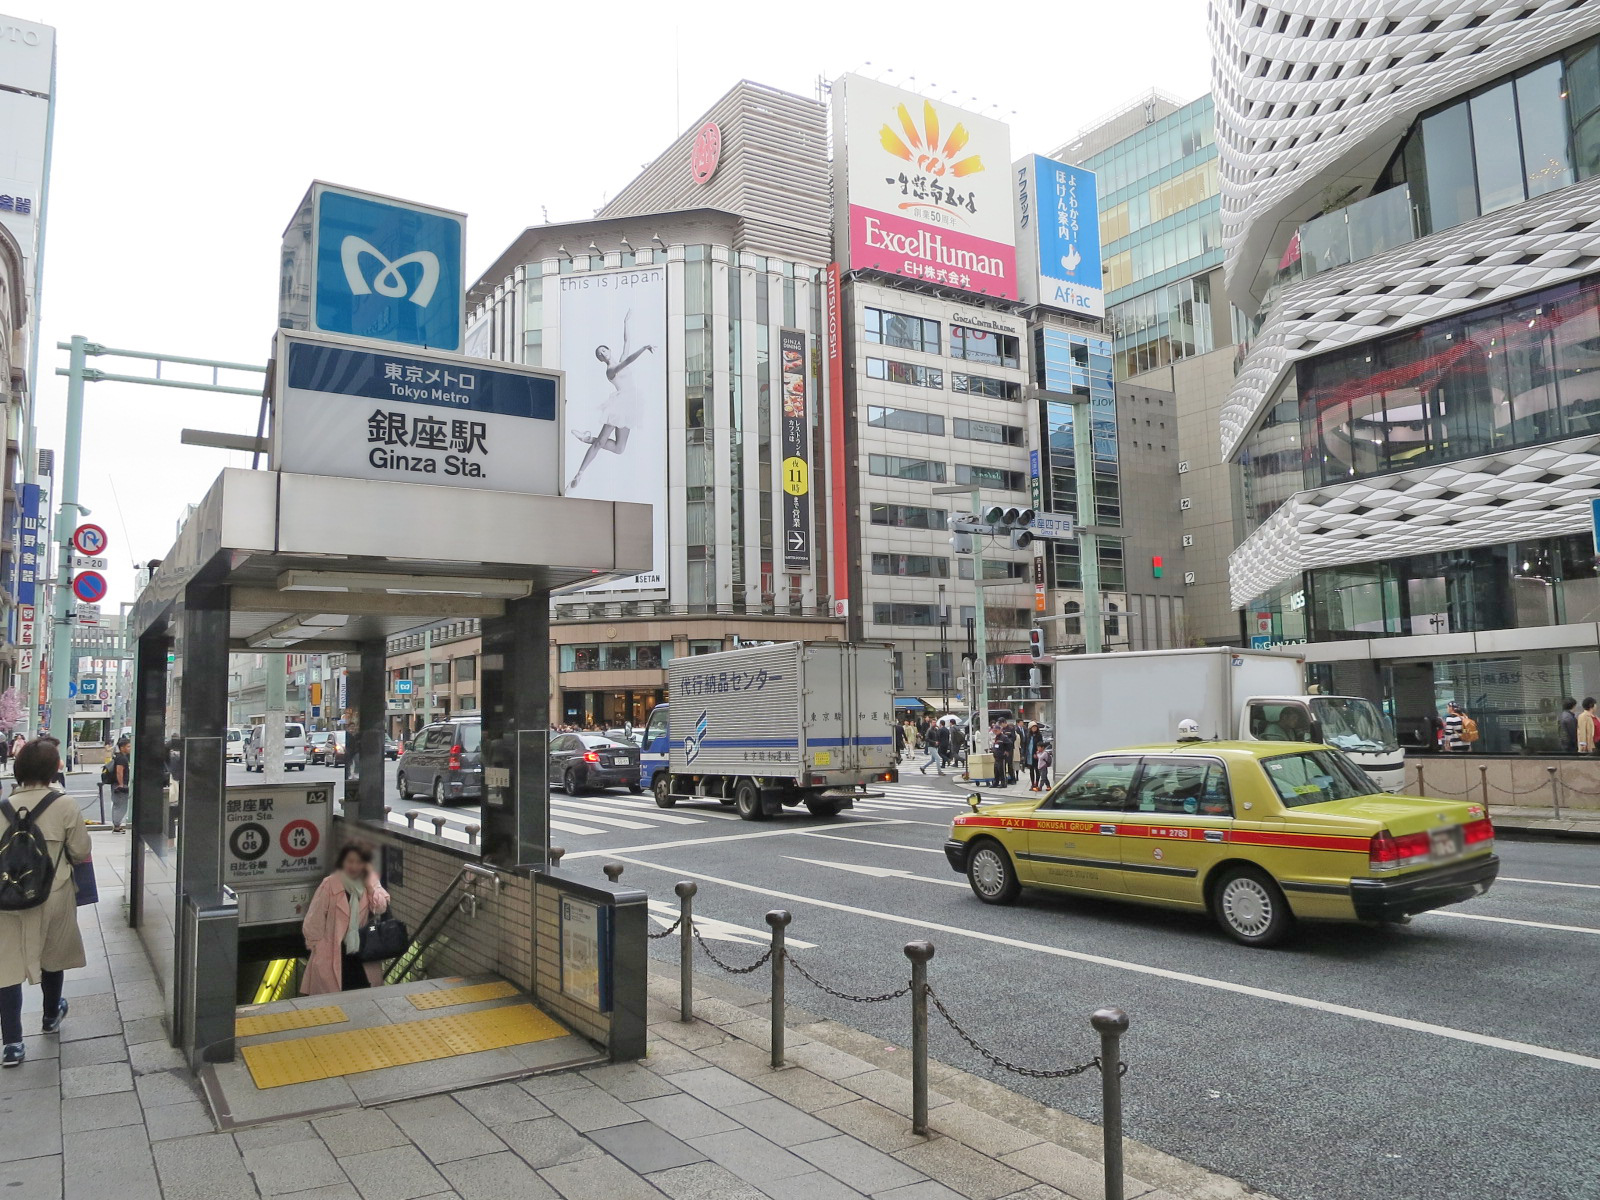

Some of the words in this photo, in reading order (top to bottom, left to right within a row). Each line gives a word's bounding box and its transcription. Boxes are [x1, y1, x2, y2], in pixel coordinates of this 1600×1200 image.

[1017, 166, 1030, 230] アフラック
[1056, 169, 1070, 240] ほけん案内
[913, 206, 957, 227] 創業50周年
[865, 215, 1005, 278] ExcelHuman
[560, 276, 590, 291] this
[597, 277, 608, 288] is
[615, 270, 664, 290] japan.
[903, 260, 971, 288] EH株式会社
[828, 269, 838, 360] MITSUKOSHI
[783, 338, 802, 346] GINZA
[783, 343, 802, 351] DINING
[384, 362, 475, 390] 東京メトロ
[390, 383, 428, 401] Tokyo
[431, 389, 470, 405] Metro
[367, 409, 489, 455] 銀座駅
[368, 447, 437, 474] Ginza
[444, 455, 487, 479] Sta.
[22, 516, 37, 583] 山野楽器
[680, 668, 783, 696] 代行納品センター
[226, 798, 274, 813] 銀座駅
[308, 792, 326, 803] A2
[227, 813, 254, 822] Ginza
[256, 812, 274, 821] Sta.
[1001, 818, 1025, 827] TAXI
[1037, 821, 1067, 830] KOKUSAI
[1070, 823, 1094, 831] GROUP
[246, 832, 254, 840] H
[294, 838, 307, 847] 16
[295, 829, 304, 837] M
[1168, 829, 1188, 838] 2783
[242, 841, 257, 851] 08
